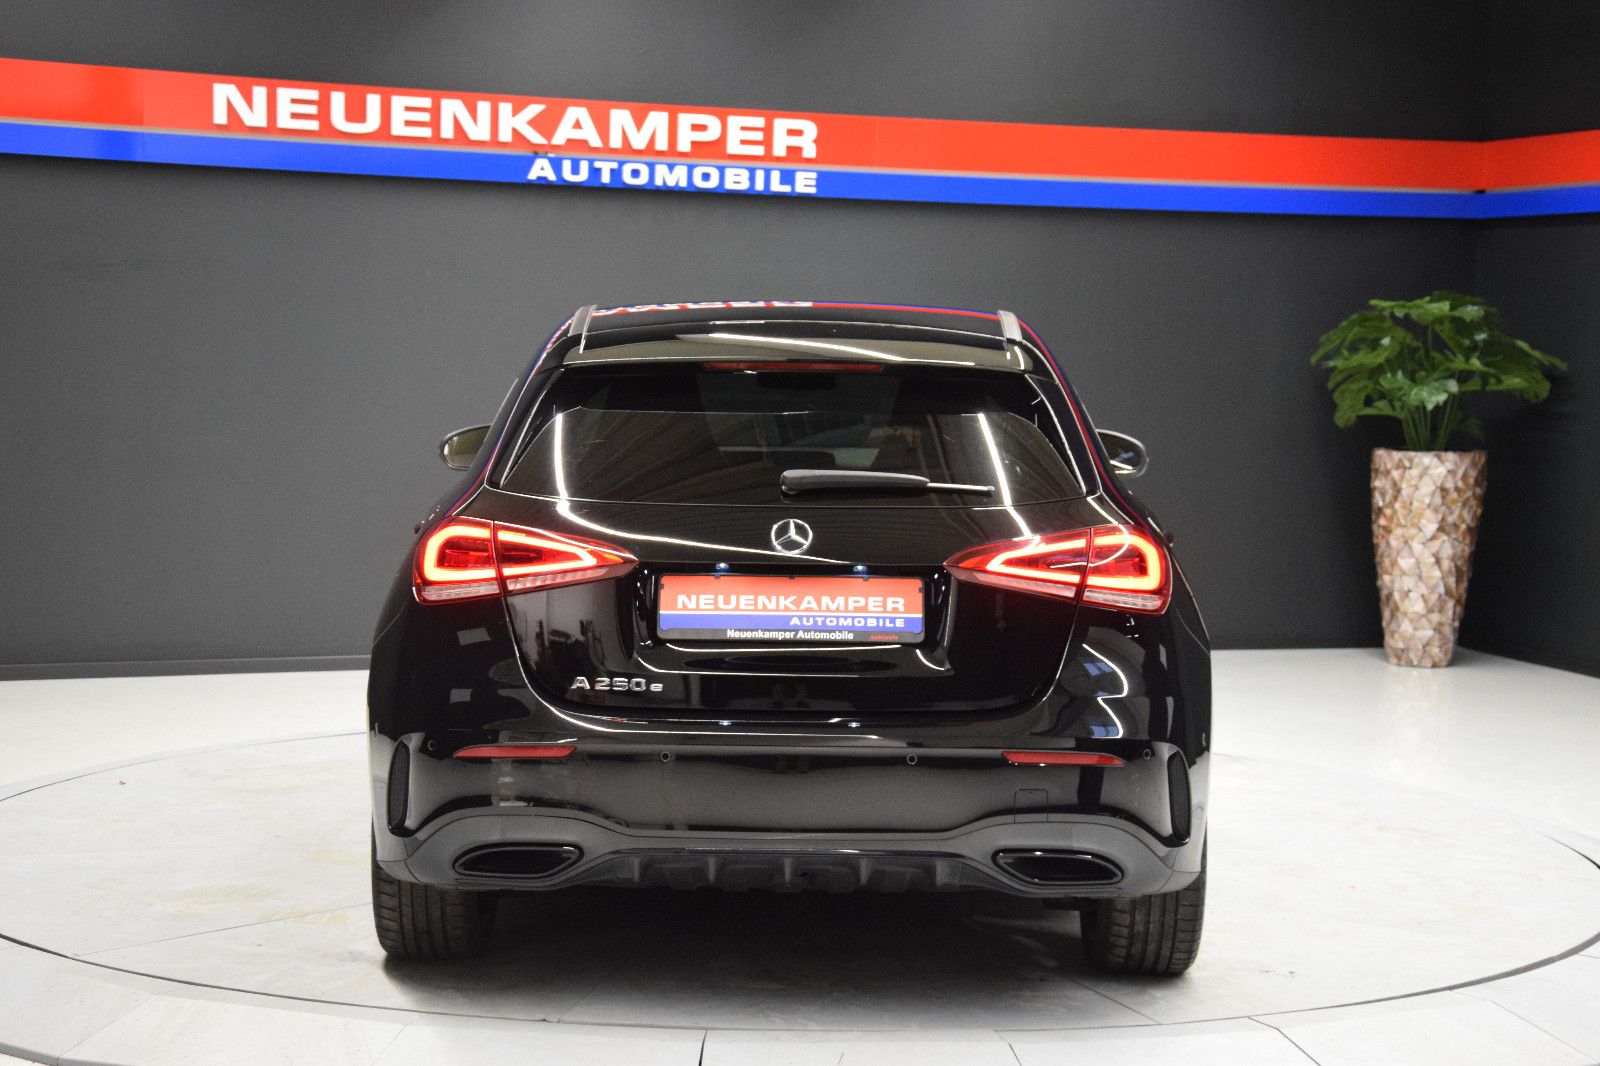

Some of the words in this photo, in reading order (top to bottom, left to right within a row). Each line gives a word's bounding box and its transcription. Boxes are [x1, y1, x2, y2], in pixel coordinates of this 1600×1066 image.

[213, 82, 818, 159] NEUENKAMPER
[527, 157, 818, 194] AUTOMOBILE
[676, 594, 905, 612] NEUENKAMPER
[789, 616, 905, 628] AUTOMOBILE
[726, 629, 795, 640] Neuenkamper
[797, 630, 854, 640] Automobile
[570, 676, 590, 690] A
